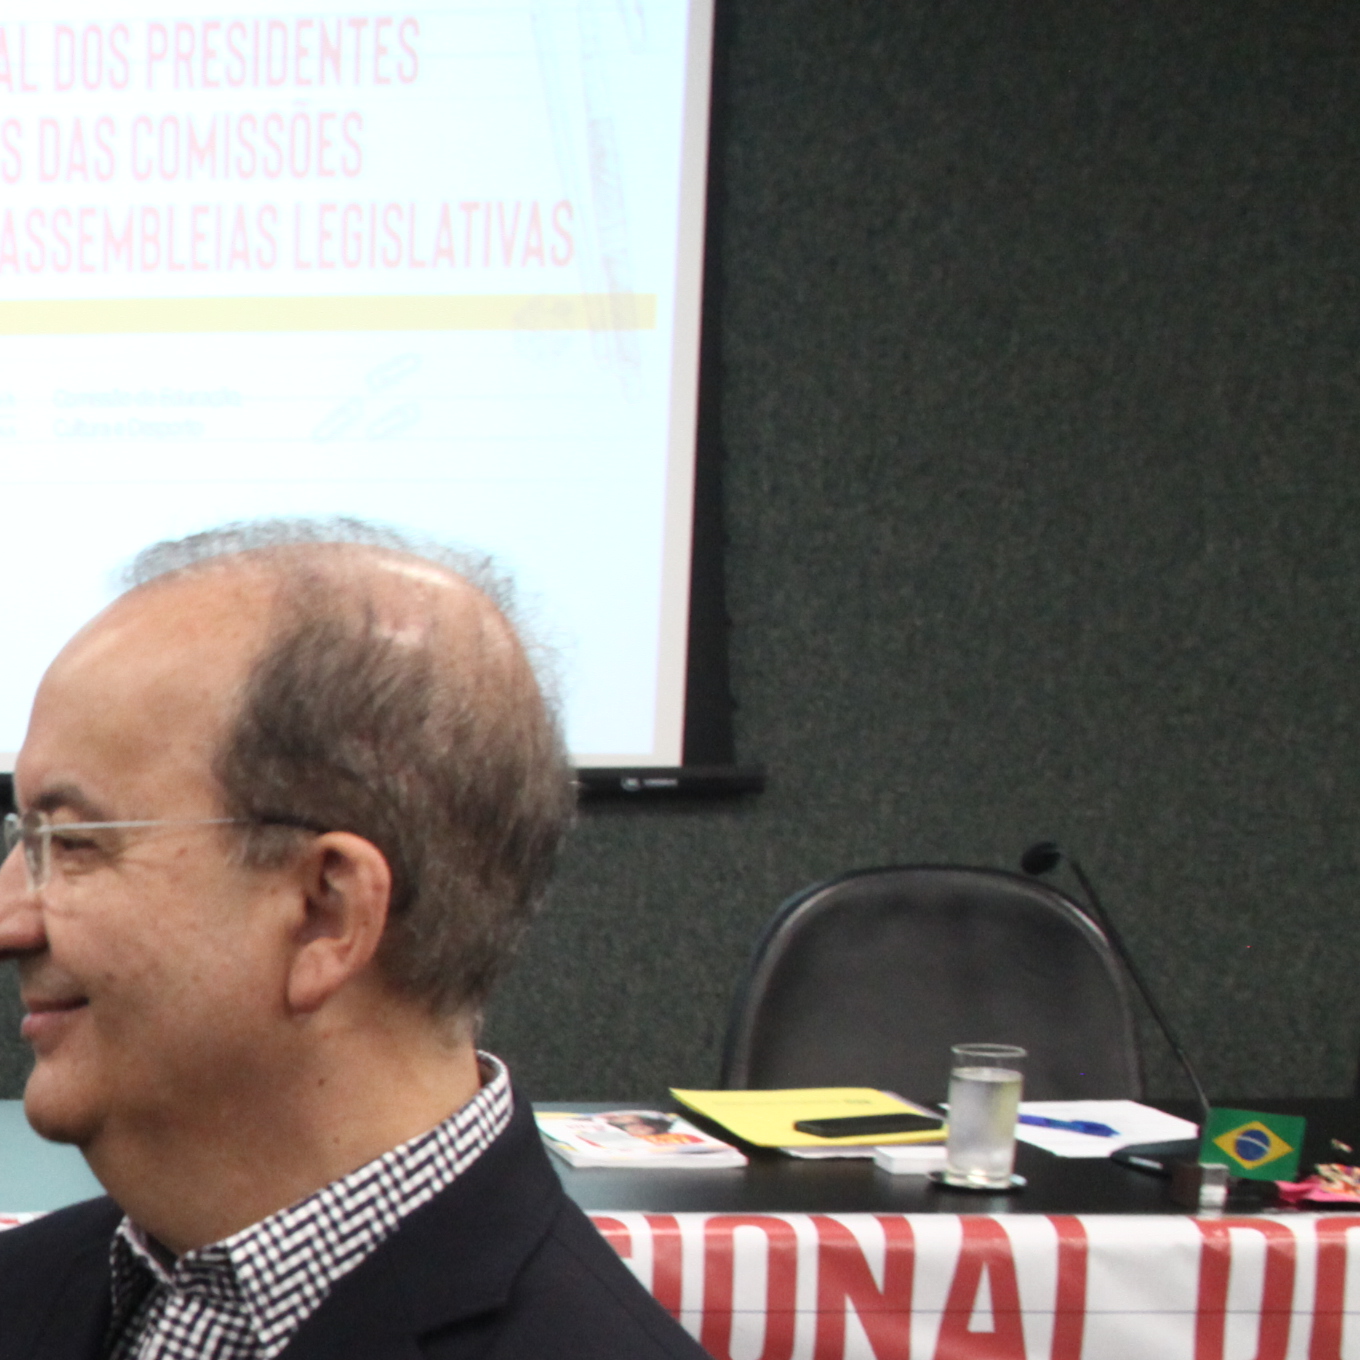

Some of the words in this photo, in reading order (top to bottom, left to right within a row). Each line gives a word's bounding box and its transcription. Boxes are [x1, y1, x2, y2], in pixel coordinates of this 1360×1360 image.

[53, 21, 131, 93] DOS
[147, 15, 422, 90] PRESIDENTES
[38, 117, 116, 184] DAS
[131, 100, 364, 182] COMISSÕES
[292, 199, 577, 270] LEGISLATIVAS
